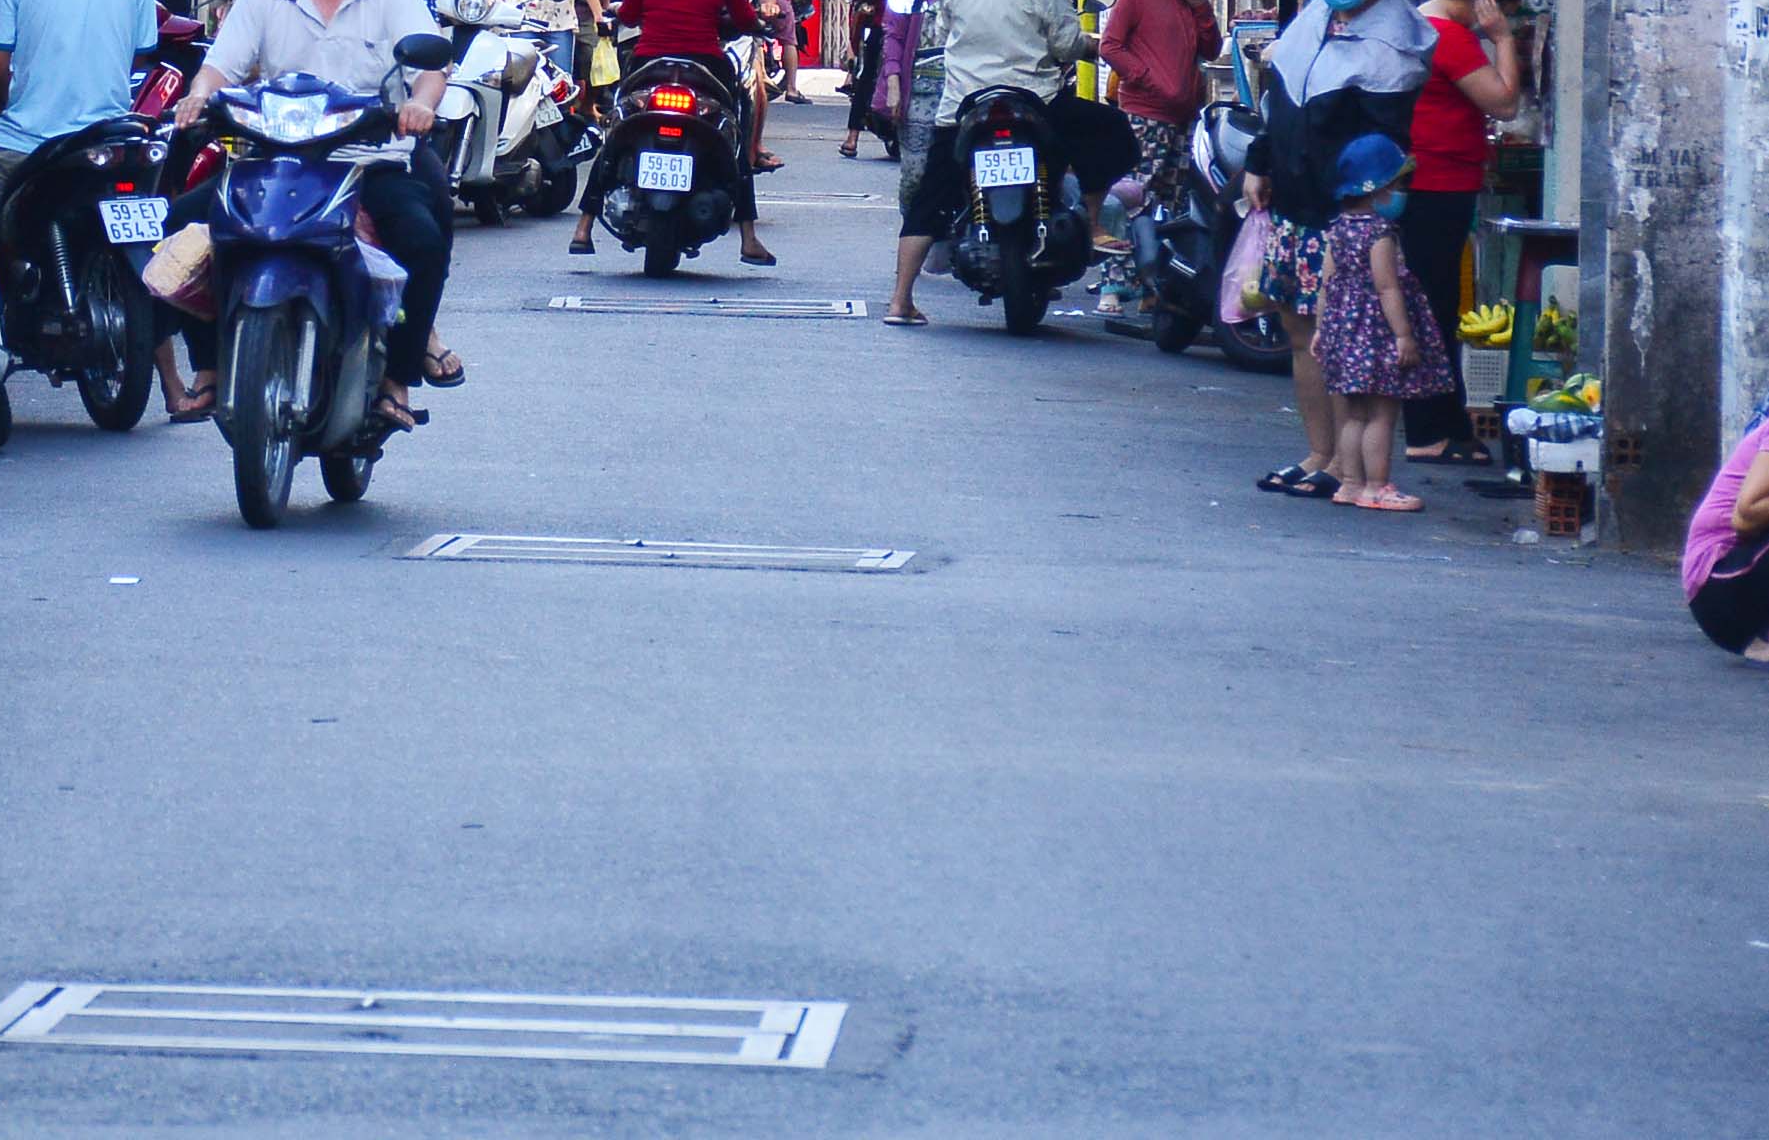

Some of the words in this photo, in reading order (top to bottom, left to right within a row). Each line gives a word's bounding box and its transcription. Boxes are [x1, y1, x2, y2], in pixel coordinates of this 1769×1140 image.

[648, 156, 683, 172] 59-G1
[984, 151, 1023, 168] 59-E1
[110, 203, 158, 220] 59-E1
[110, 221, 161, 239] 654.5
